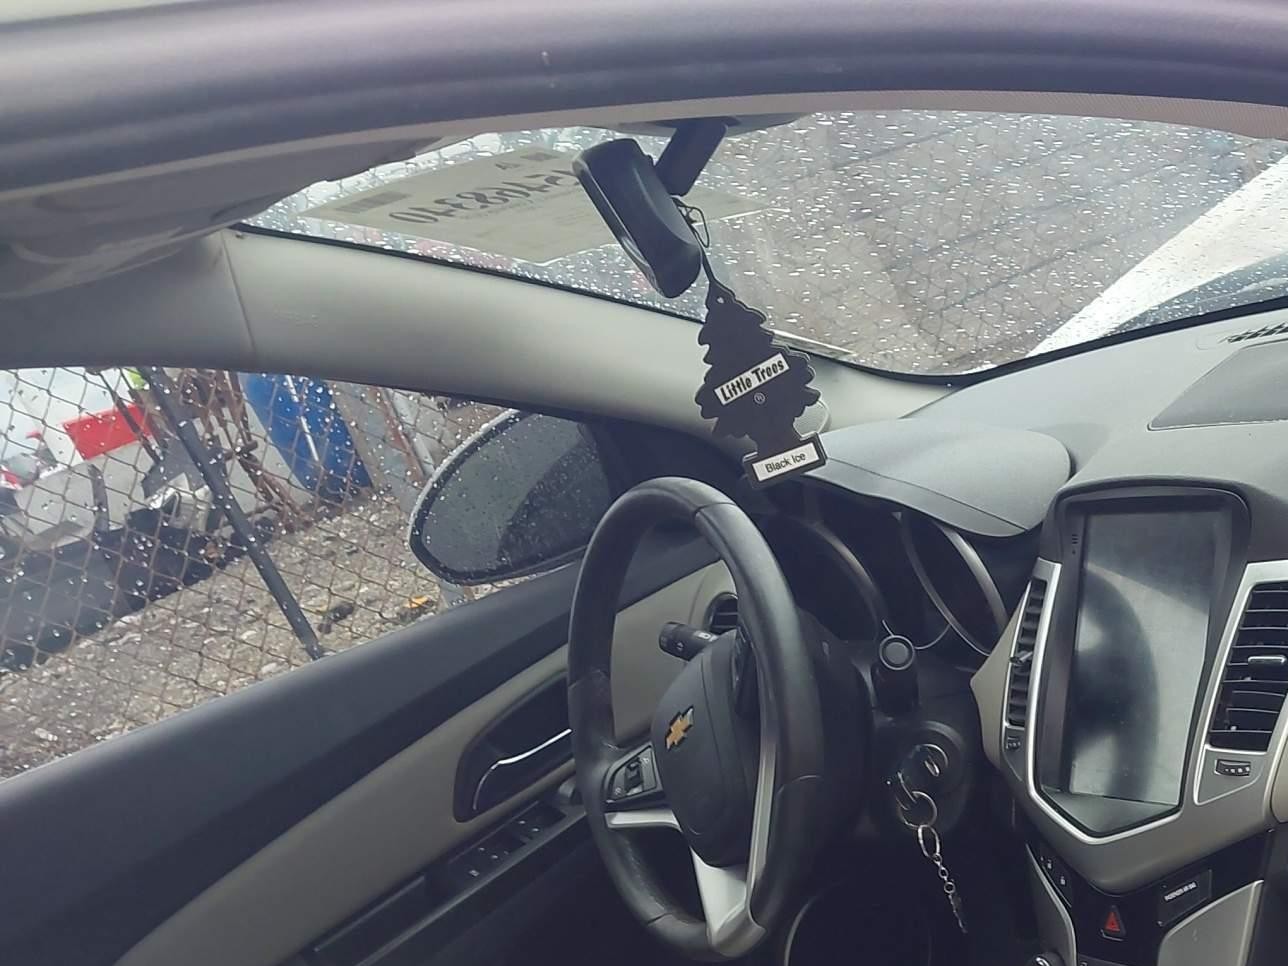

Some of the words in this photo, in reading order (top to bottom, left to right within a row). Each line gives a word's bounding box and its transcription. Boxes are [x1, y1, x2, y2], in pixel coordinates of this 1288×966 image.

[719, 376, 753, 402] Little
[751, 359, 785, 383] Trees
[765, 457, 792, 473] Black
[792, 452, 806, 465] Ice
